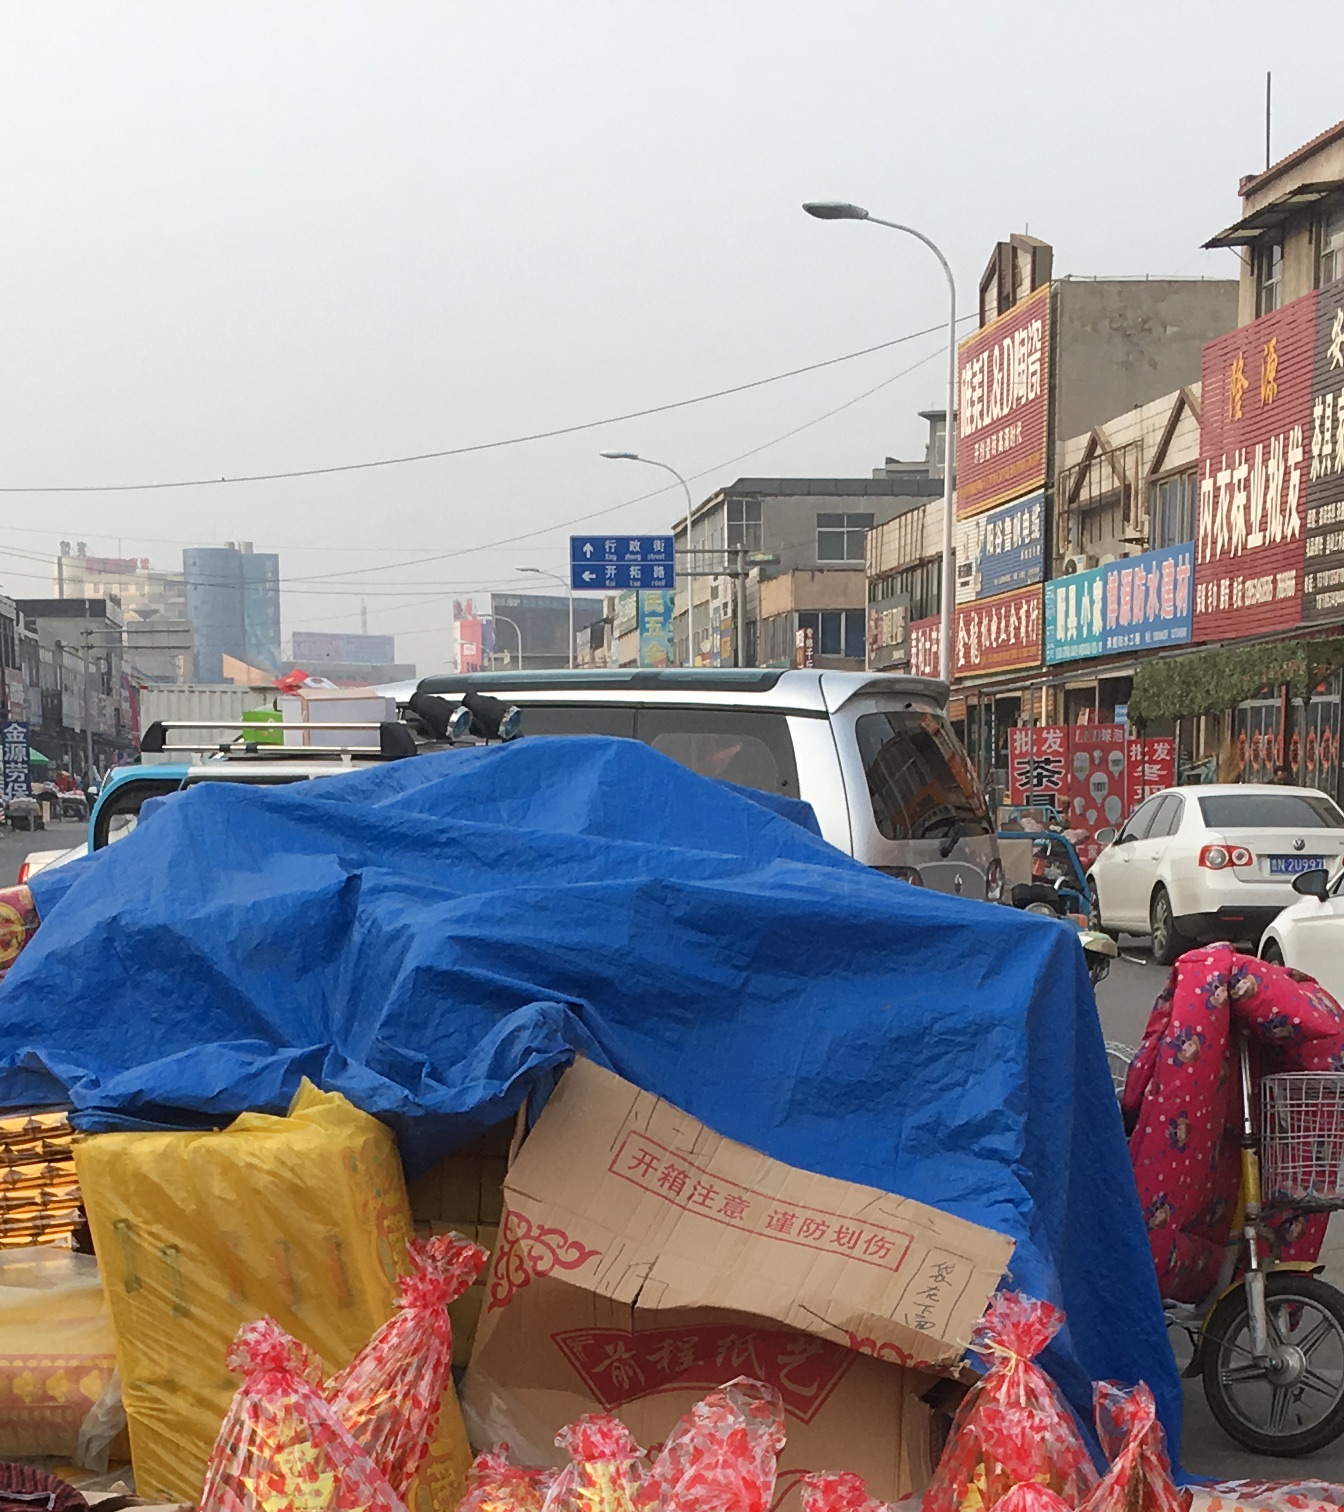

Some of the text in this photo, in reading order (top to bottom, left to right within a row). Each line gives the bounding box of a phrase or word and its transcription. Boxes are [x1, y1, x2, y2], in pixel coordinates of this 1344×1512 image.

[1198, 425, 1304, 565] 内衣袜业批发
[605, 540, 665, 552] 行政街
[605, 565, 666, 579] 开拓路
[3, 722, 30, 800] 金源劳保
[1014, 729, 1065, 755] 批发
[1130, 742, 1171, 762] 批发
[626, 1146, 897, 1261] 开箱注意 谨防划伤
[592, 1327, 825, 1398] 前程纸艺
